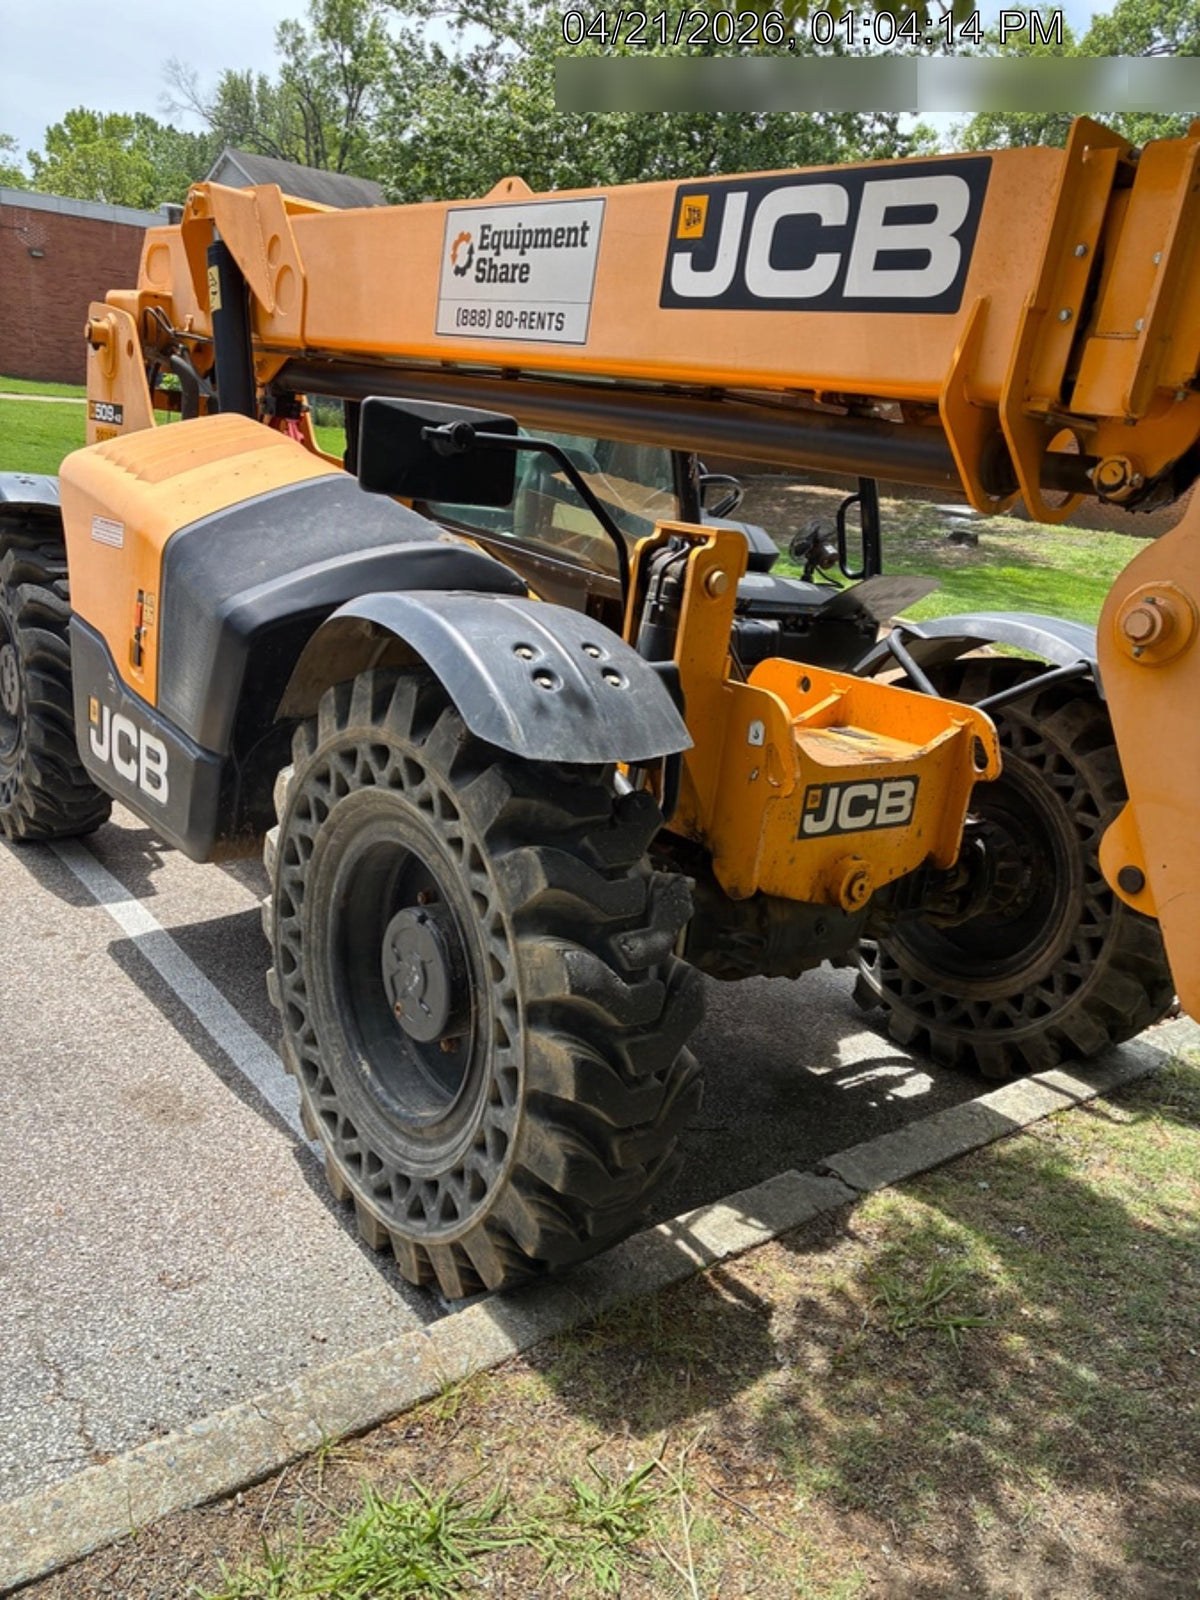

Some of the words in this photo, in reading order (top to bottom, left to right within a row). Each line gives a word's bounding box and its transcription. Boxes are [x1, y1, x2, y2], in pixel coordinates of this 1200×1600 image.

[478, 220, 590, 256] Equipment
[671, 175, 970, 298] JCB
[474, 257, 531, 284] Share
[456, 307, 492, 329] (888)
[495, 309, 566, 332] 80-RENTS
[90, 705, 169, 804] JCB
[804, 780, 915, 834] JCB
